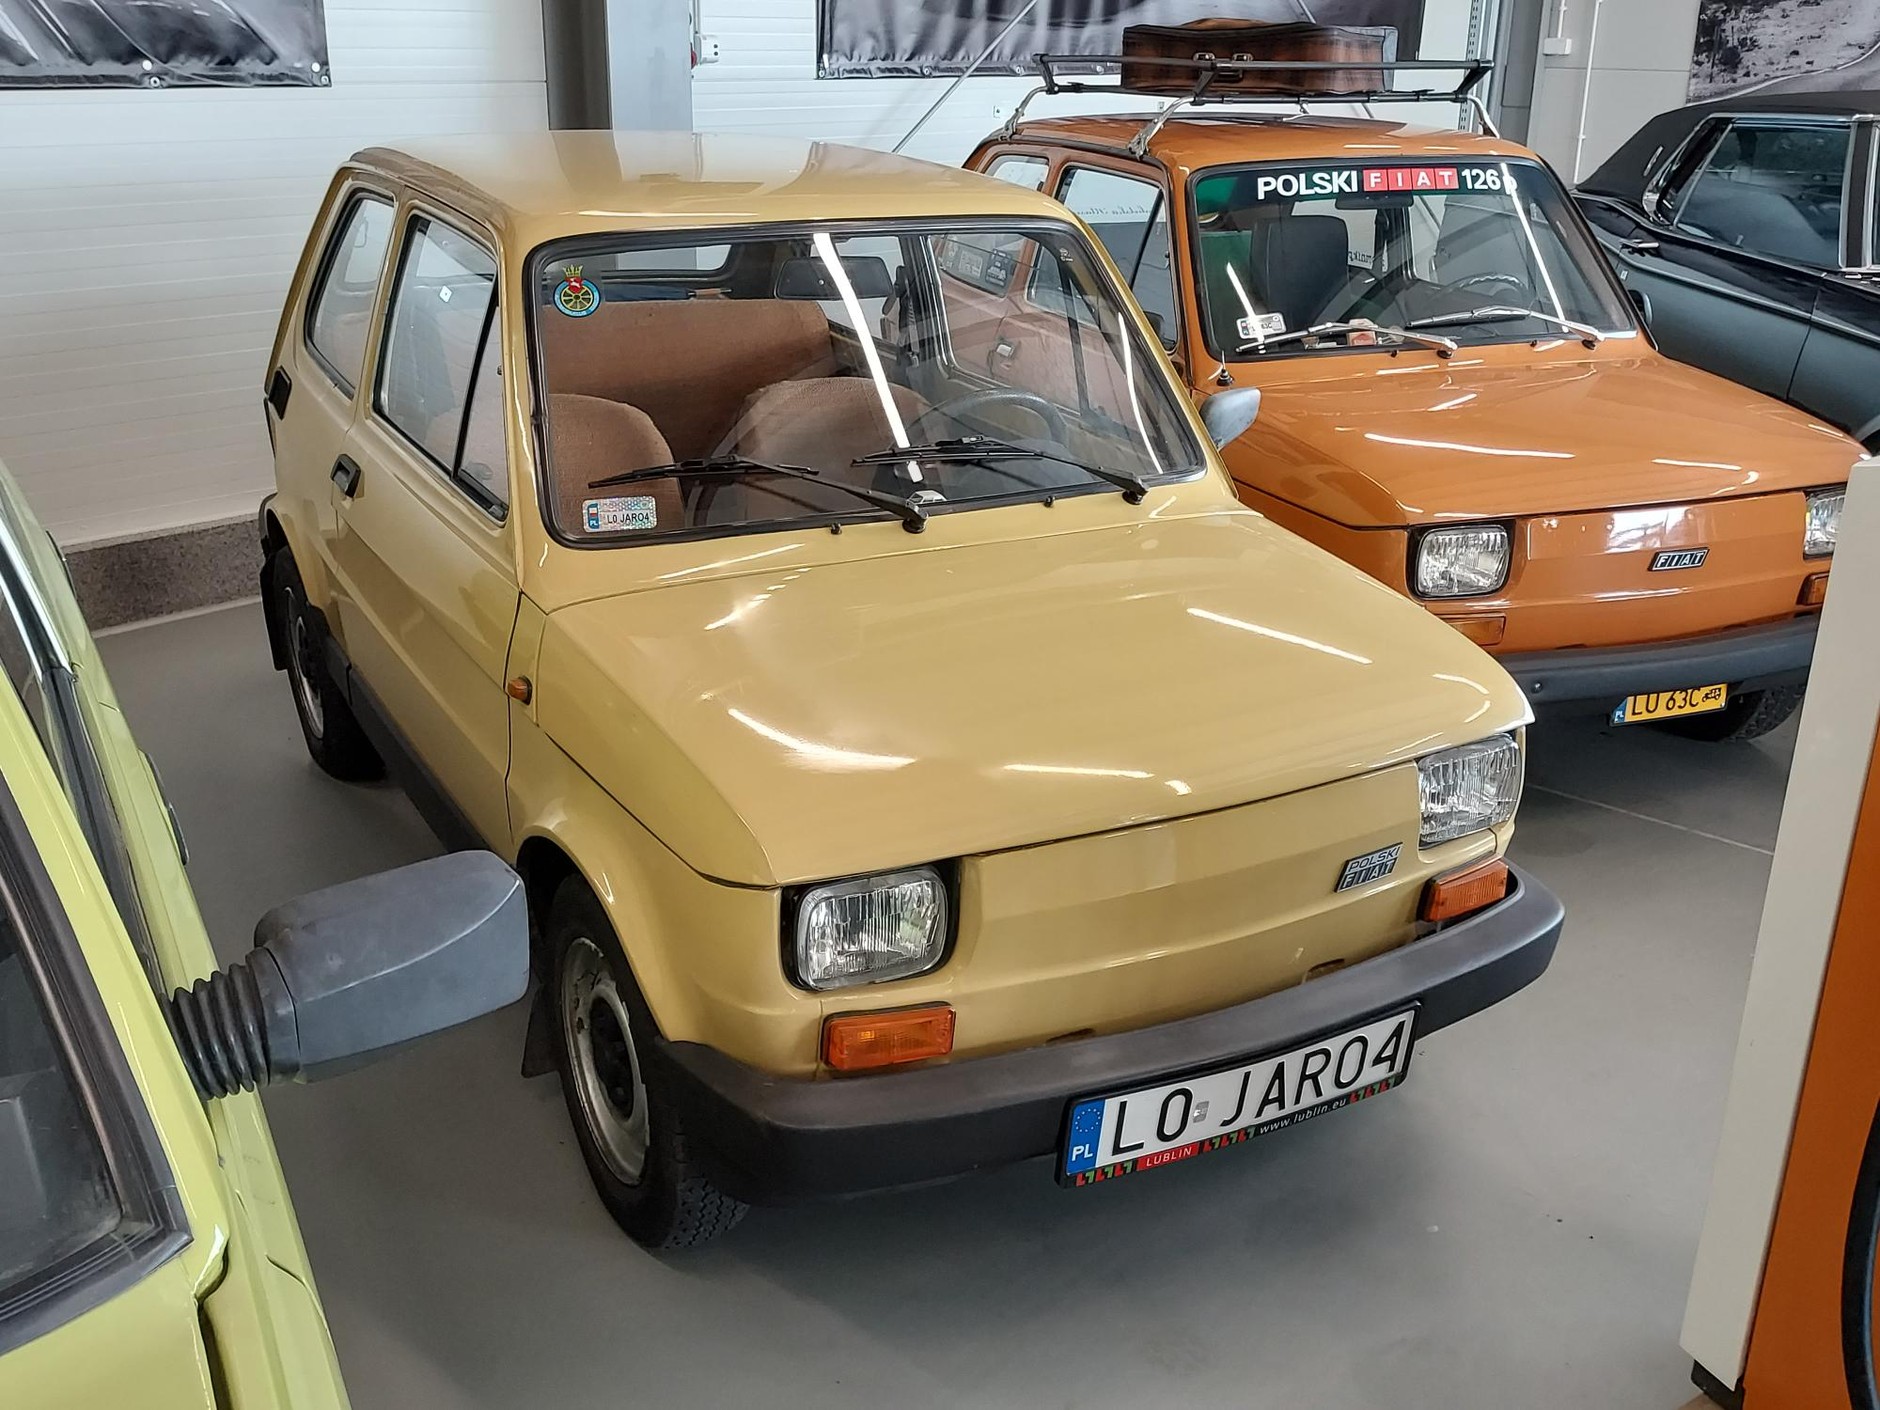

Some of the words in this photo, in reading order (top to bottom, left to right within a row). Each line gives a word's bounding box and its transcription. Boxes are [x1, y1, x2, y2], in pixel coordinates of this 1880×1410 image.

[1257, 170, 1358, 200] POLSKI
[1368, 170, 1454, 188] FIAT
[1655, 552, 1705, 568] FIAT
[1631, 693, 1660, 716] LU
[1348, 846, 1401, 872] POLSKI
[1342, 860, 1395, 888] FIAT
[1259, 1098, 1347, 1134] www.lublin.eu
[1071, 1143, 1094, 1162] PL
[1146, 1146, 1193, 1167] LUBLIN
